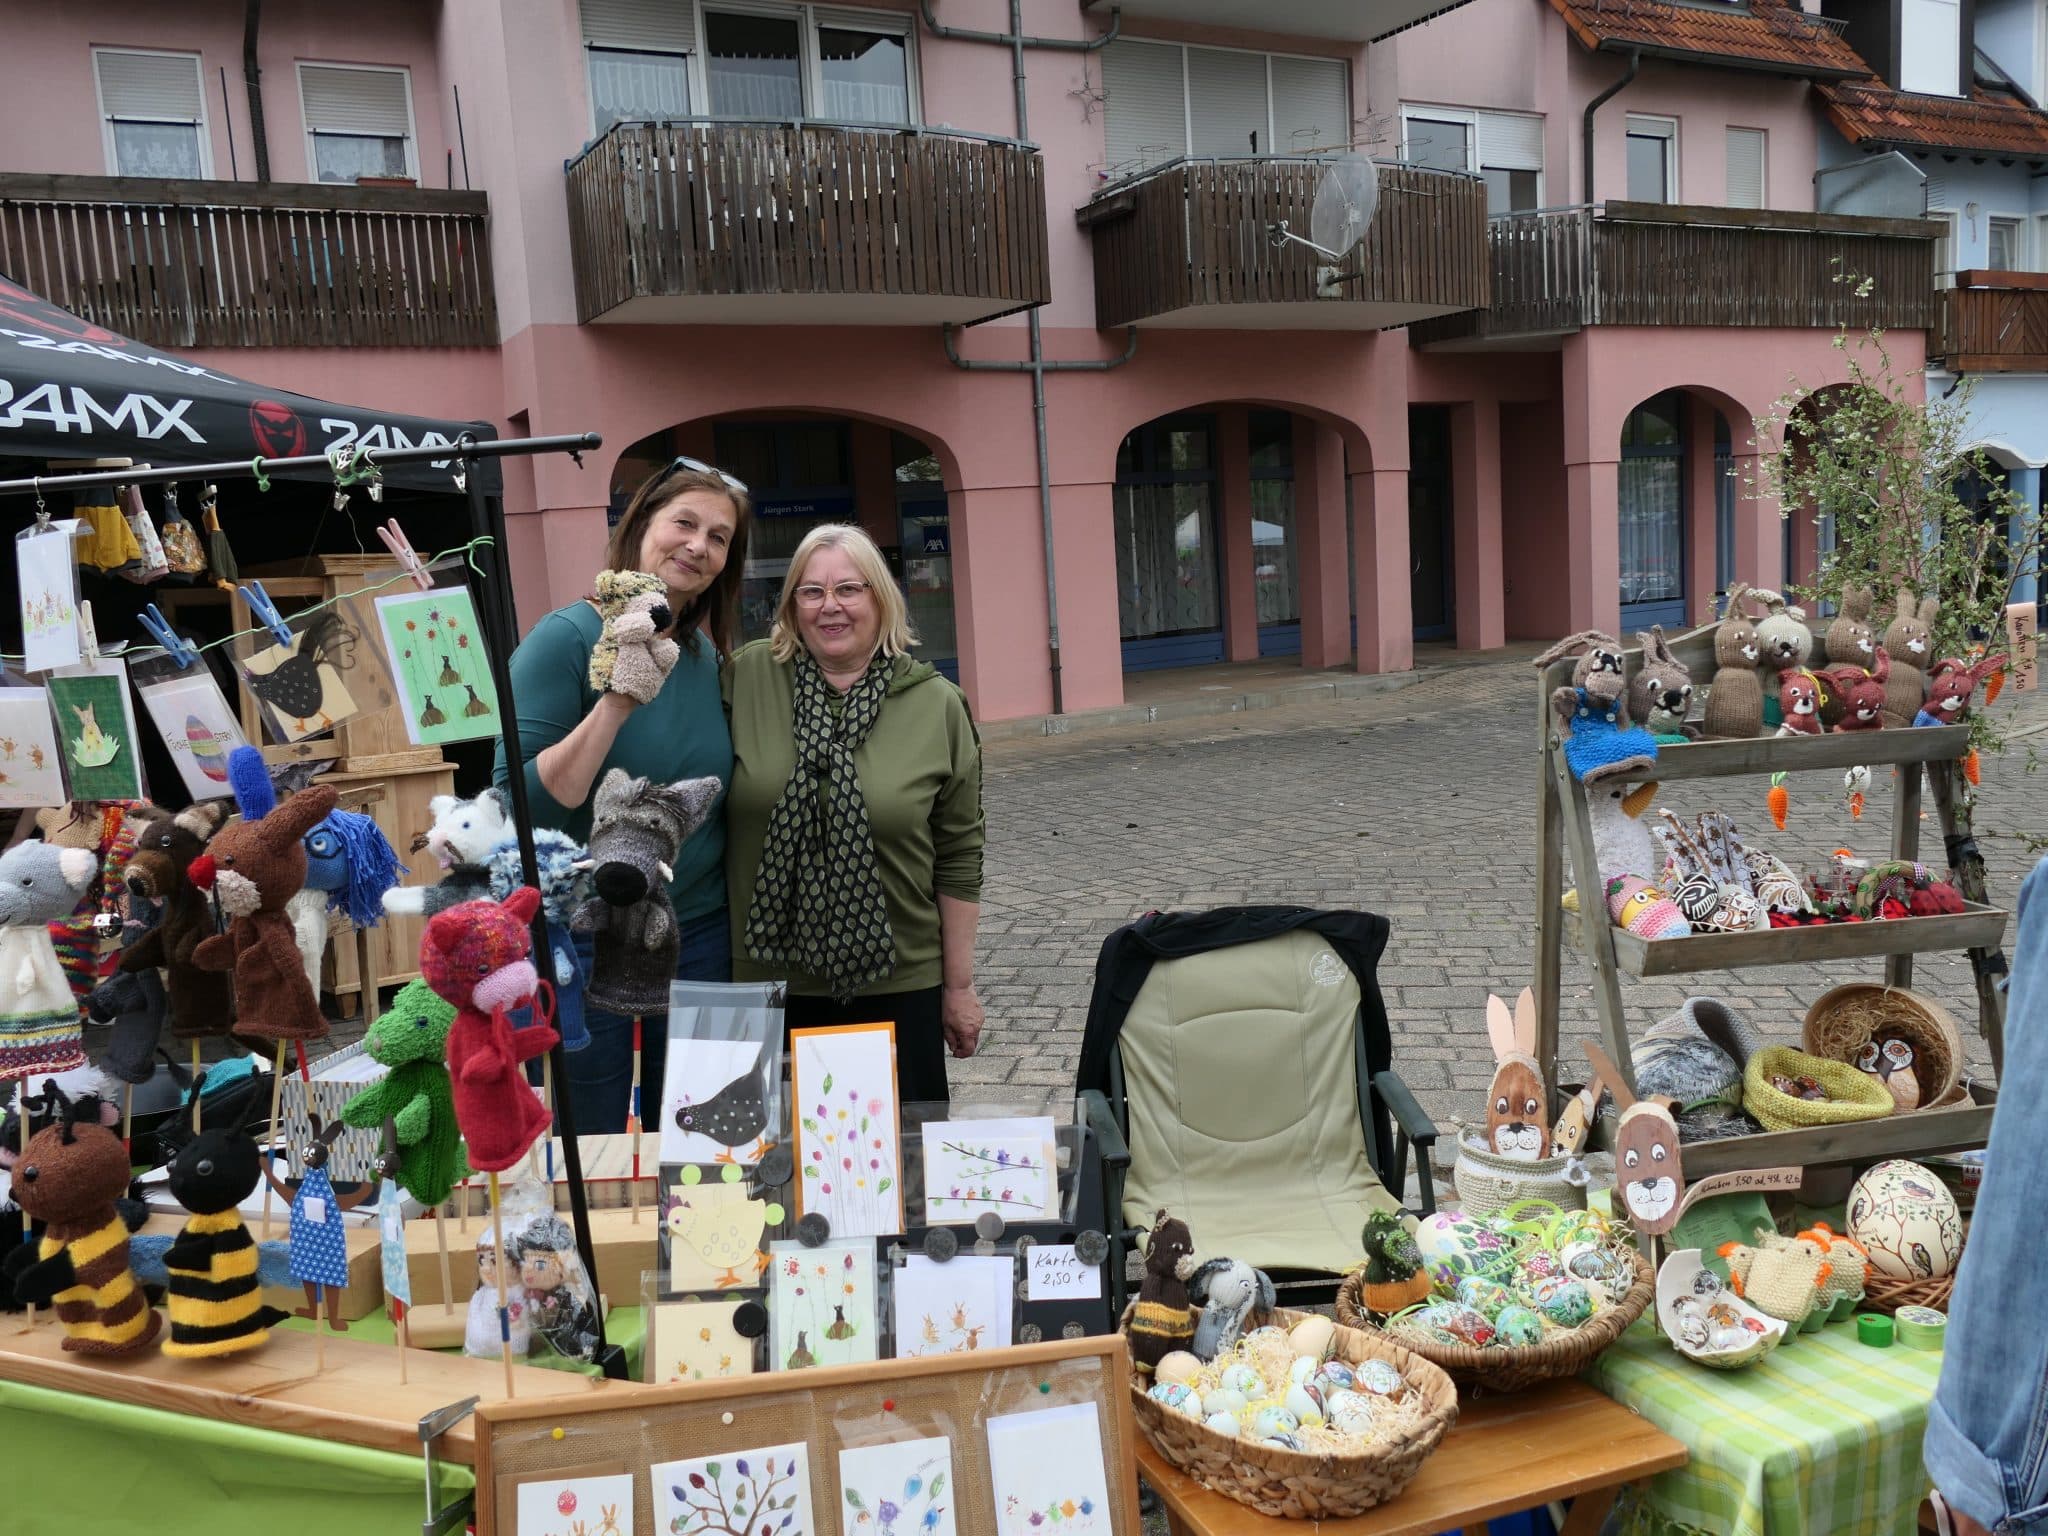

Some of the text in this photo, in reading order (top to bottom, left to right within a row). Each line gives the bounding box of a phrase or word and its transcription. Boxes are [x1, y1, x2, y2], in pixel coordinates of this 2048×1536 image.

[763, 504, 792, 516] Jürgen
[924, 538, 945, 552] AXA
[1041, 1271, 1088, 1287] 2,50 €
